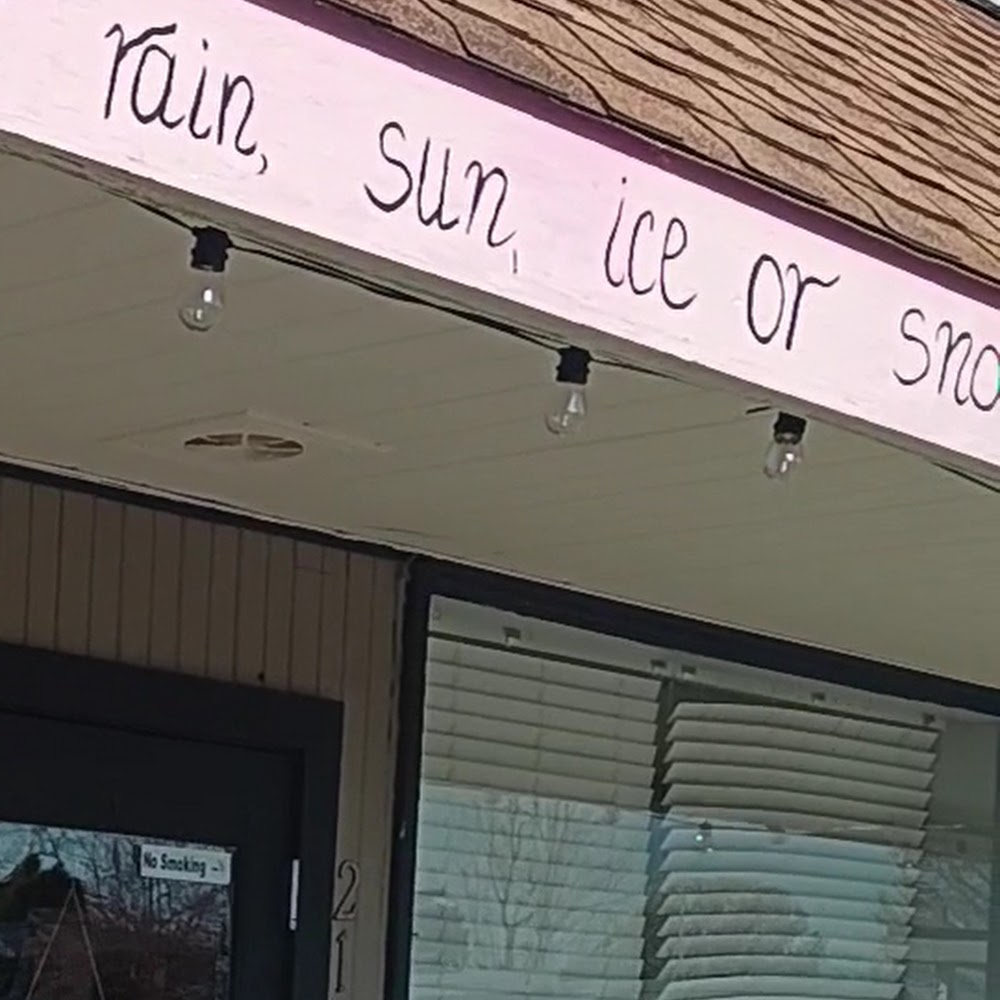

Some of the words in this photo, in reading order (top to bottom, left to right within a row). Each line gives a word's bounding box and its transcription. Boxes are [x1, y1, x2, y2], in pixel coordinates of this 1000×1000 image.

[103, 22, 268, 176] rain,
[363, 120, 519, 275] sun,
[603, 176, 698, 310] ice
[745, 252, 841, 351] or
[143, 851, 158, 869] No
[160, 852, 206, 879] Smoking
